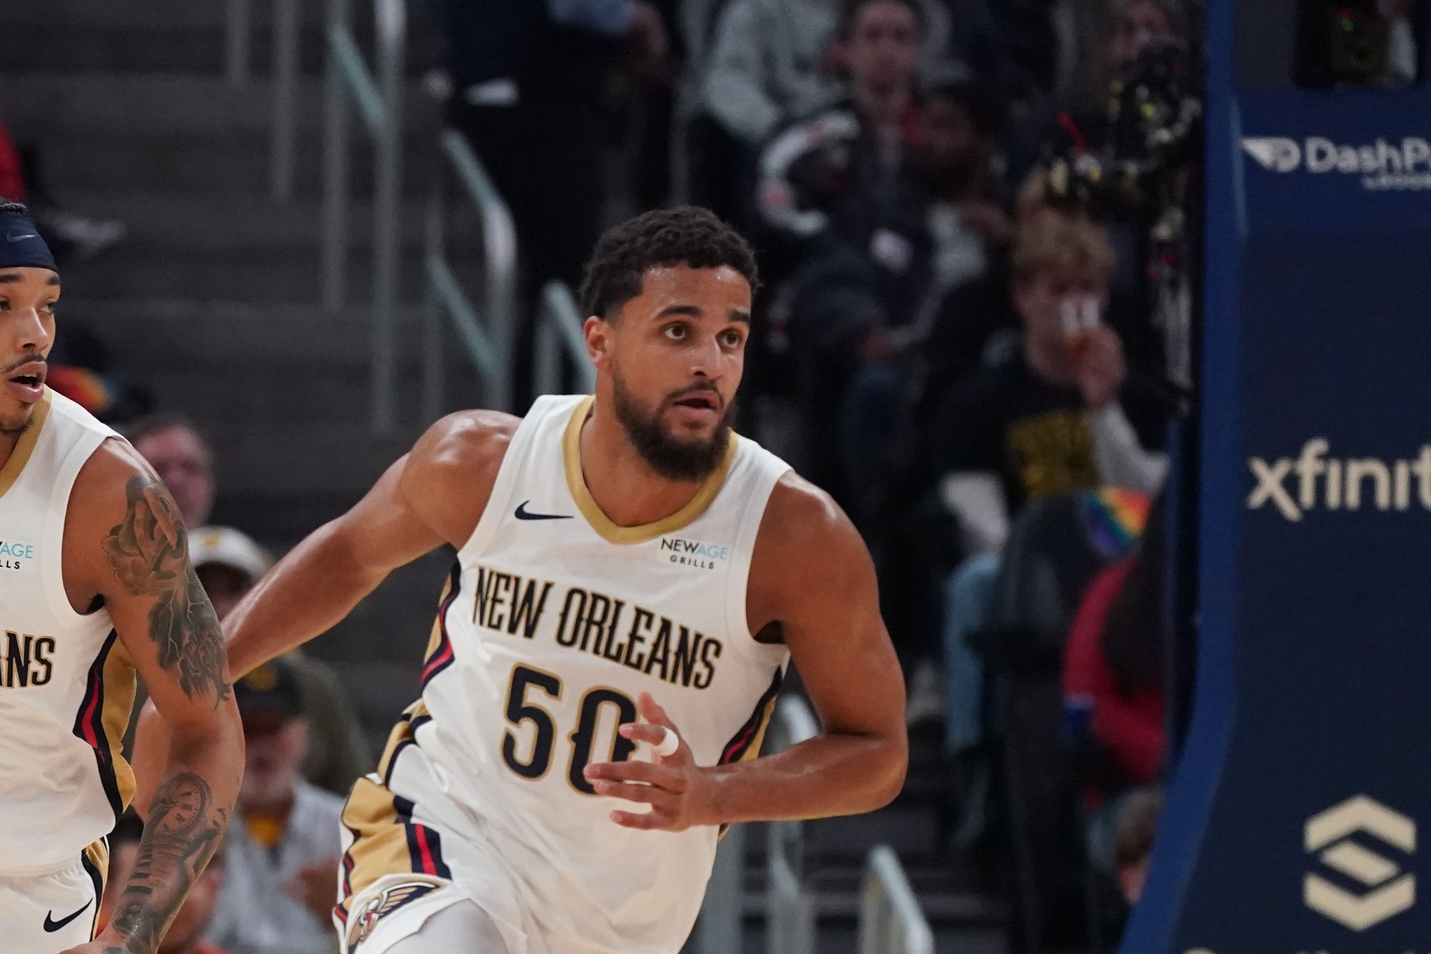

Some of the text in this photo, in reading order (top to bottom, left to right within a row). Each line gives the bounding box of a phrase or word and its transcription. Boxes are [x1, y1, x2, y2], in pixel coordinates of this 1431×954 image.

[1305, 136, 1431, 173] DashP
[670, 554, 715, 570] GRILLS
[472, 566, 722, 690] NEW ORLEANS
[501, 662, 638, 796] 50
